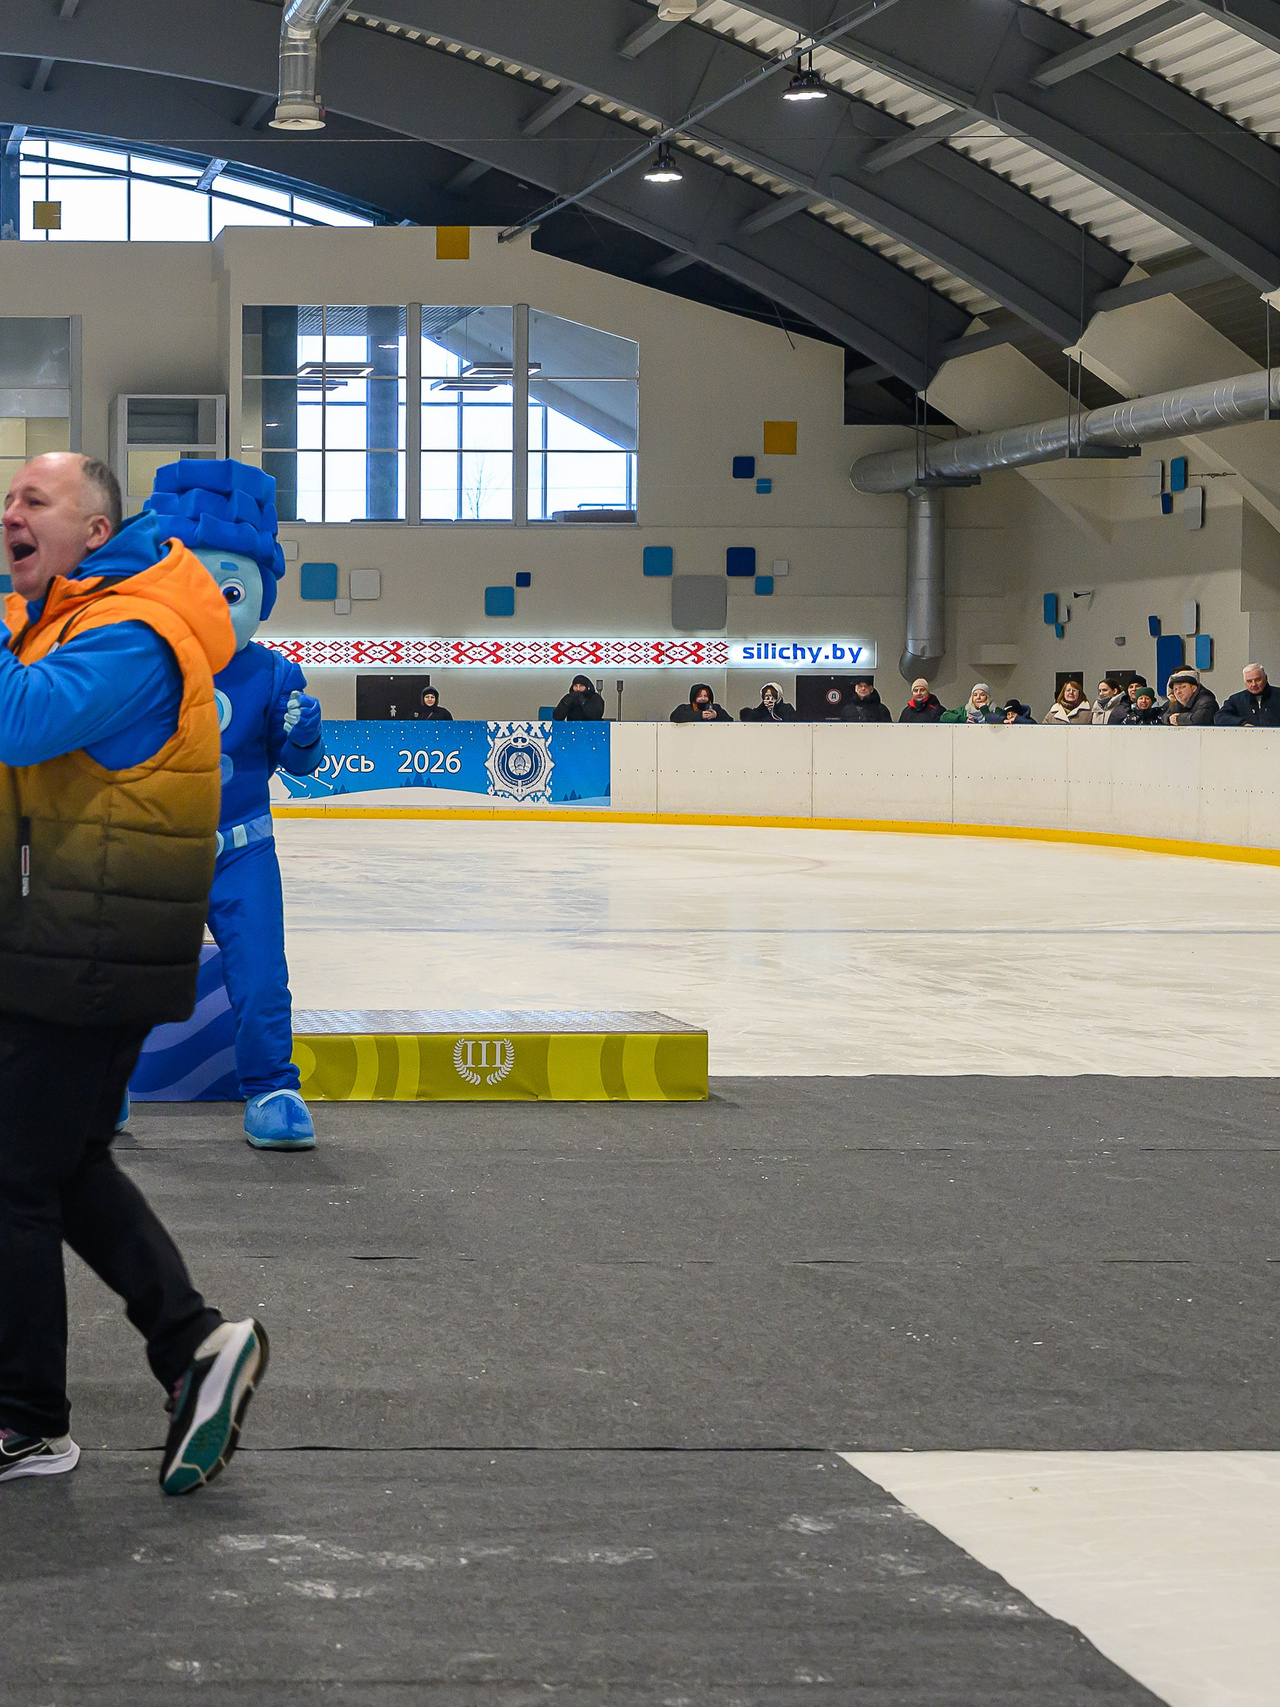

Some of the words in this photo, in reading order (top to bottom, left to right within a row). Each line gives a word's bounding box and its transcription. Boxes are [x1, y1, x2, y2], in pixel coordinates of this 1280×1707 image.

[743, 643, 863, 663] silichy.by
[397, 749, 461, 774] 2026
[463, 1040, 505, 1068] III
